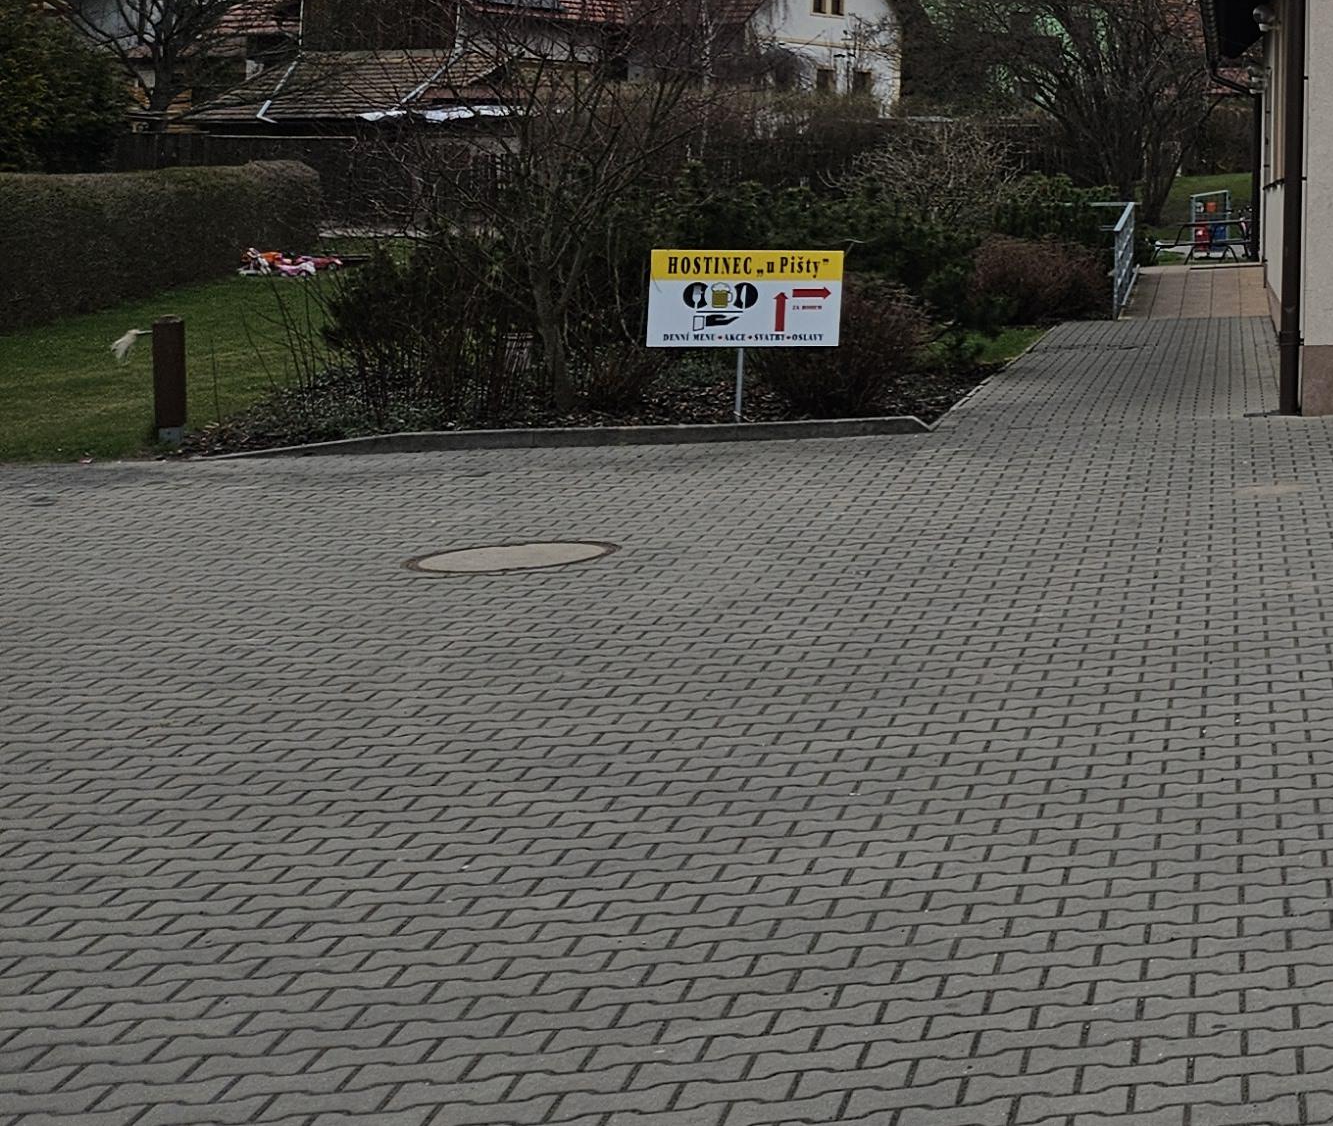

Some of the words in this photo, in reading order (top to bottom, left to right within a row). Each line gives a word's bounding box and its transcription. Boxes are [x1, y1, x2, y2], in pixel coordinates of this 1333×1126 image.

[667, 256, 752, 275] HOSTINEC
[663, 332, 689, 341] DENNÍ
[693, 333, 716, 341] MENU
[725, 333, 746, 341] AKCE
[791, 333, 824, 342] OSLAVY
